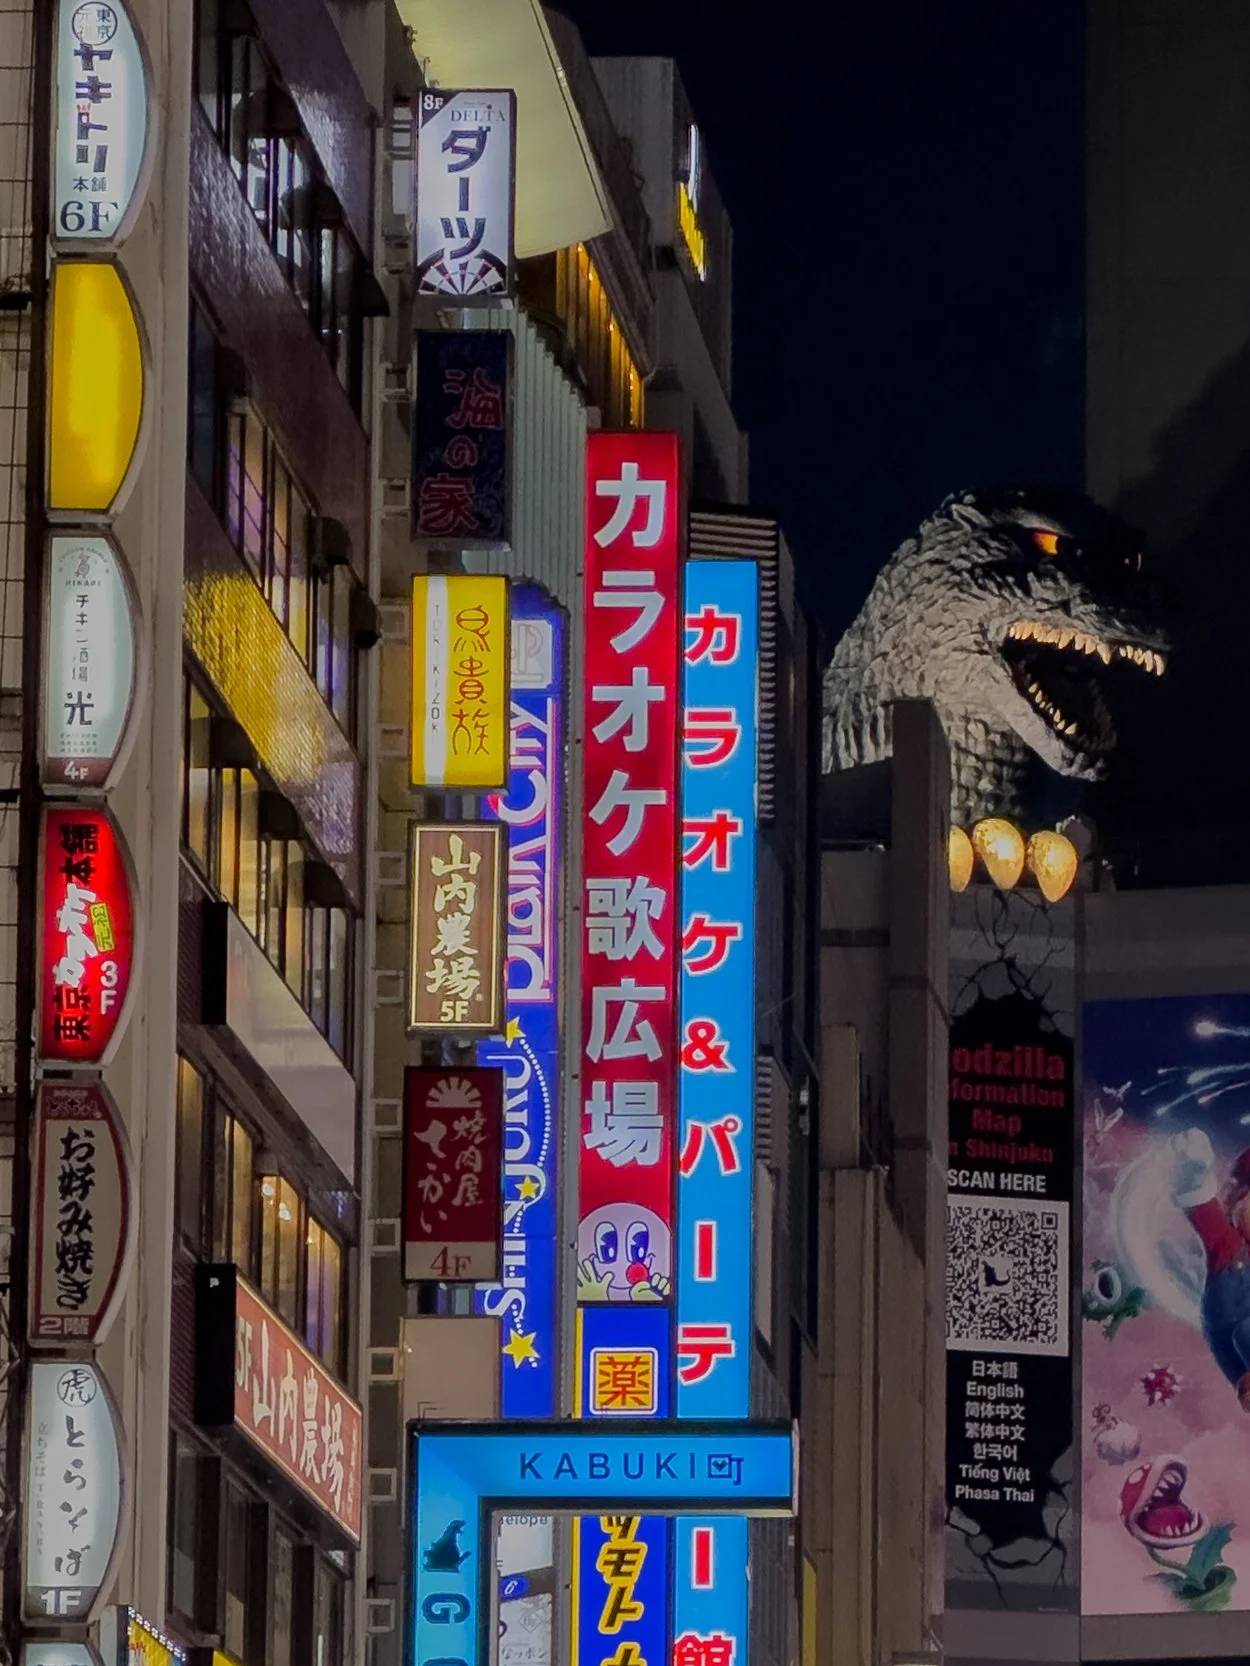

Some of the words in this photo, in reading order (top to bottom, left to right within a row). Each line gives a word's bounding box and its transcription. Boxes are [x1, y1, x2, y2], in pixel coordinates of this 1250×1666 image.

[74, 43, 113, 172] ヤキトリ
[424, 95, 443, 110] 8F
[451, 108, 506, 122] DELTA
[441, 126, 492, 260] ダーツ
[60, 201, 118, 232] 6F
[64, 690, 95, 725] 光
[64, 760, 90, 780] 4F
[584, 462, 668, 1167] カラオケ歌広場
[426, 834, 483, 1000] 山内農場
[440, 1001, 468, 1022] 5F
[972, 1108, 1022, 1137] Map
[452, 1109, 489, 1208] 焼肉屋
[965, 1138, 1054, 1164] Shinjuku
[946, 1168, 995, 1190] SCAN
[1000, 1173, 1047, 1193] HERE
[56, 1126, 96, 1311] お好み焼き
[430, 1250, 471, 1278] 4F
[39, 1316, 90, 1336] 2階
[971, 1360, 1018, 1380] 日本語
[965, 1381, 1025, 1401] English
[252, 1318, 345, 1514] 山内農場
[964, 1401, 1026, 1421] 简体中文
[972, 1442, 1018, 1463] 한국어
[1002, 1464, 1032, 1483] Việt
[55, 1415, 92, 1576] とらそば
[954, 1484, 999, 1502] Phasa
[1001, 1486, 1035, 1503] Thai
[41, 1590, 82, 1615] 1F
